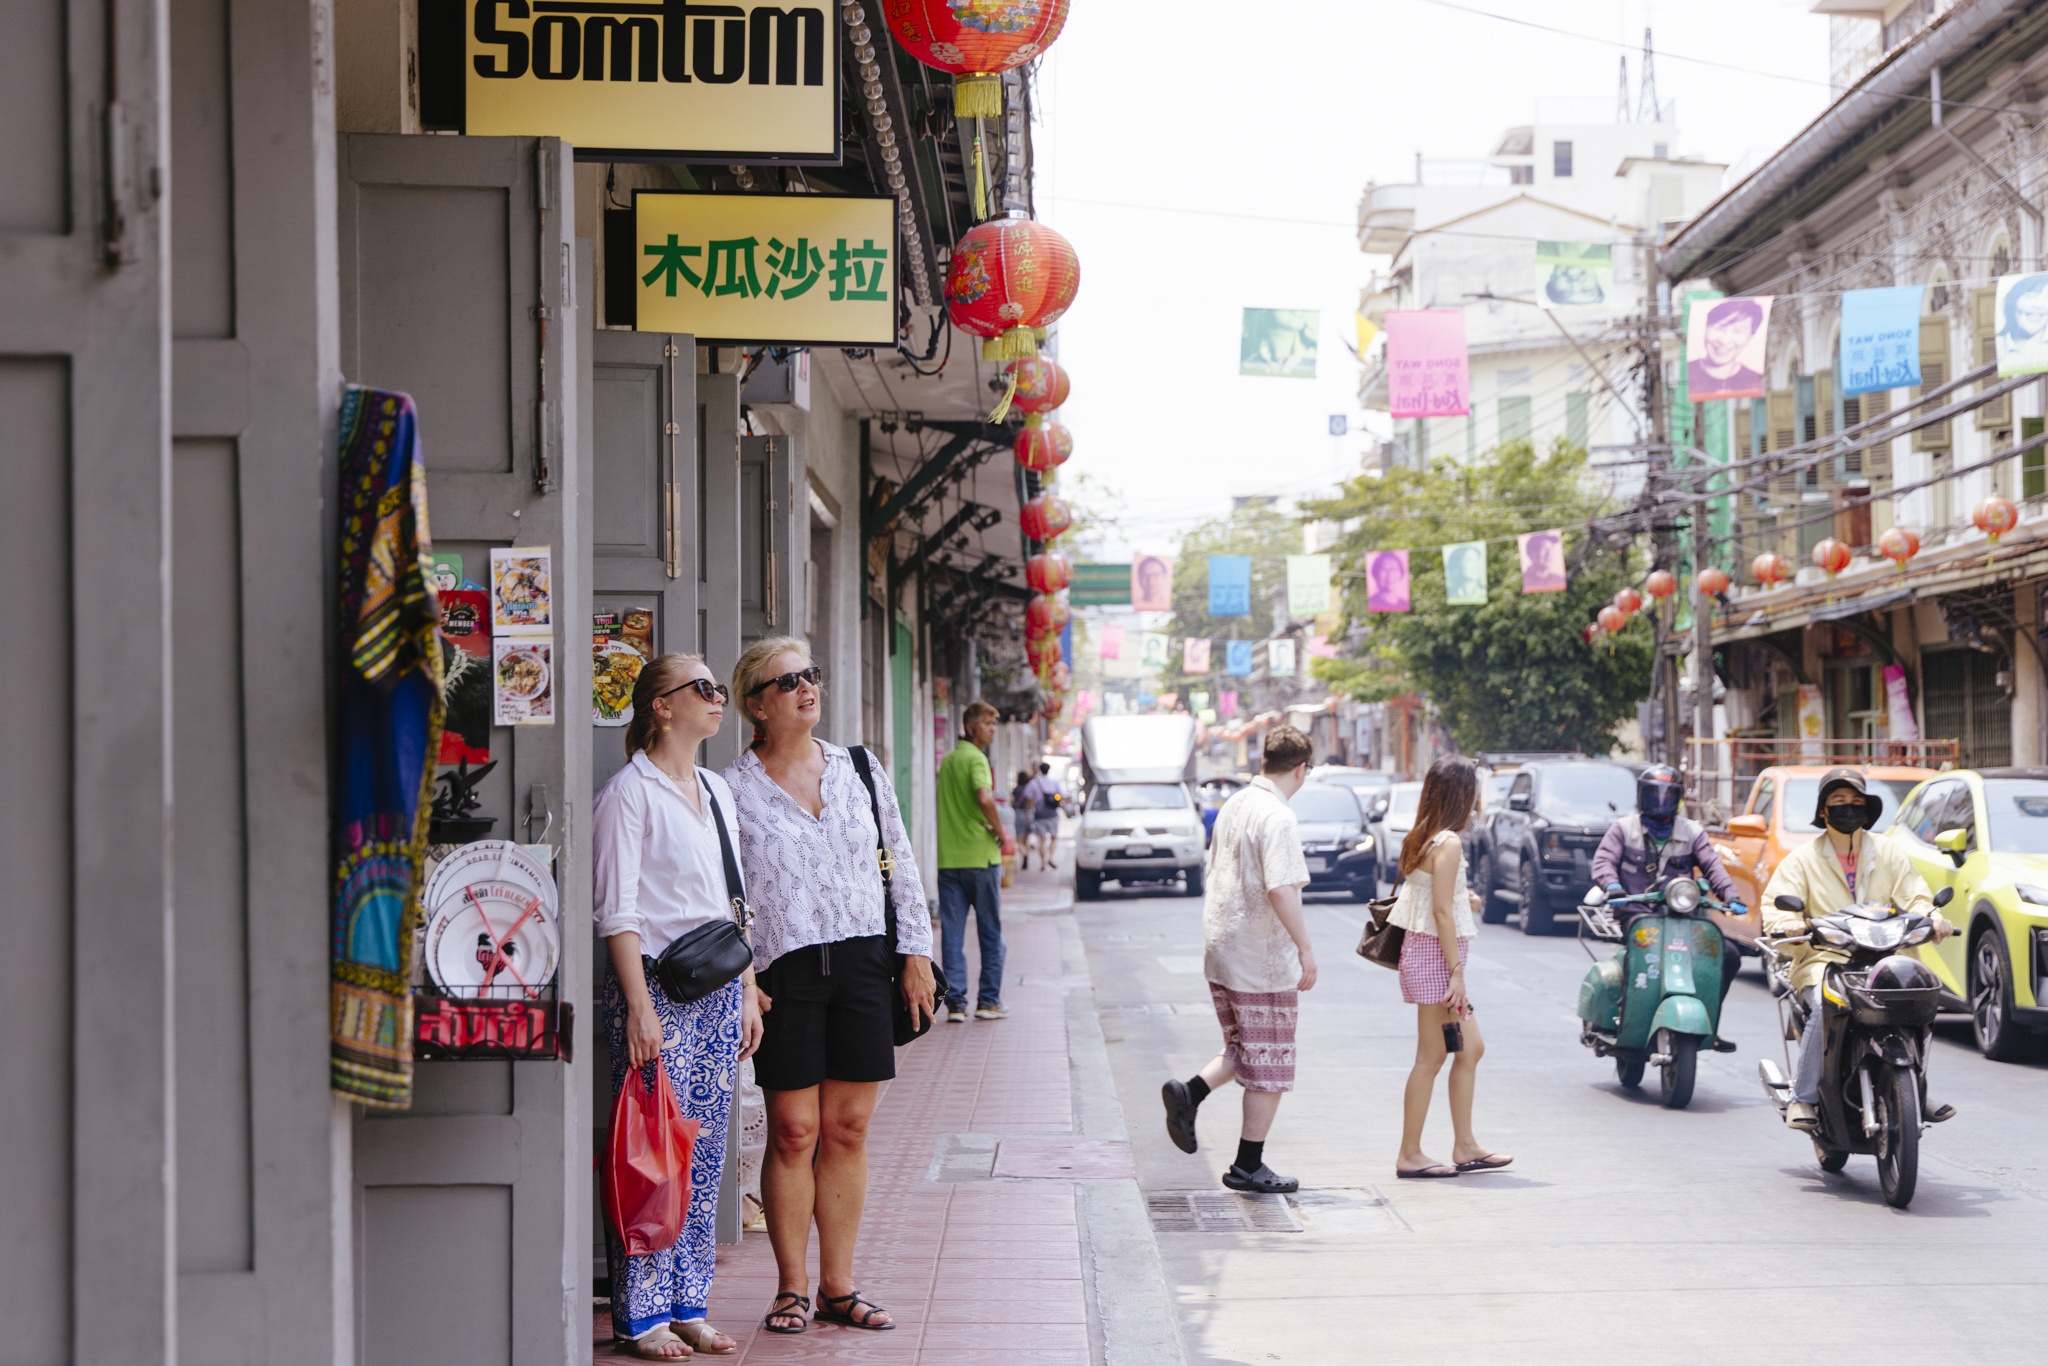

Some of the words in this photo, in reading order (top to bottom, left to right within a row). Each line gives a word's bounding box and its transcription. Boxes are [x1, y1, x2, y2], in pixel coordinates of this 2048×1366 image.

[641, 233, 888, 302] 木瓜沙拉
[596, 617, 612, 625] Thai
[419, 1000, 546, 1050] ส้มตำ
